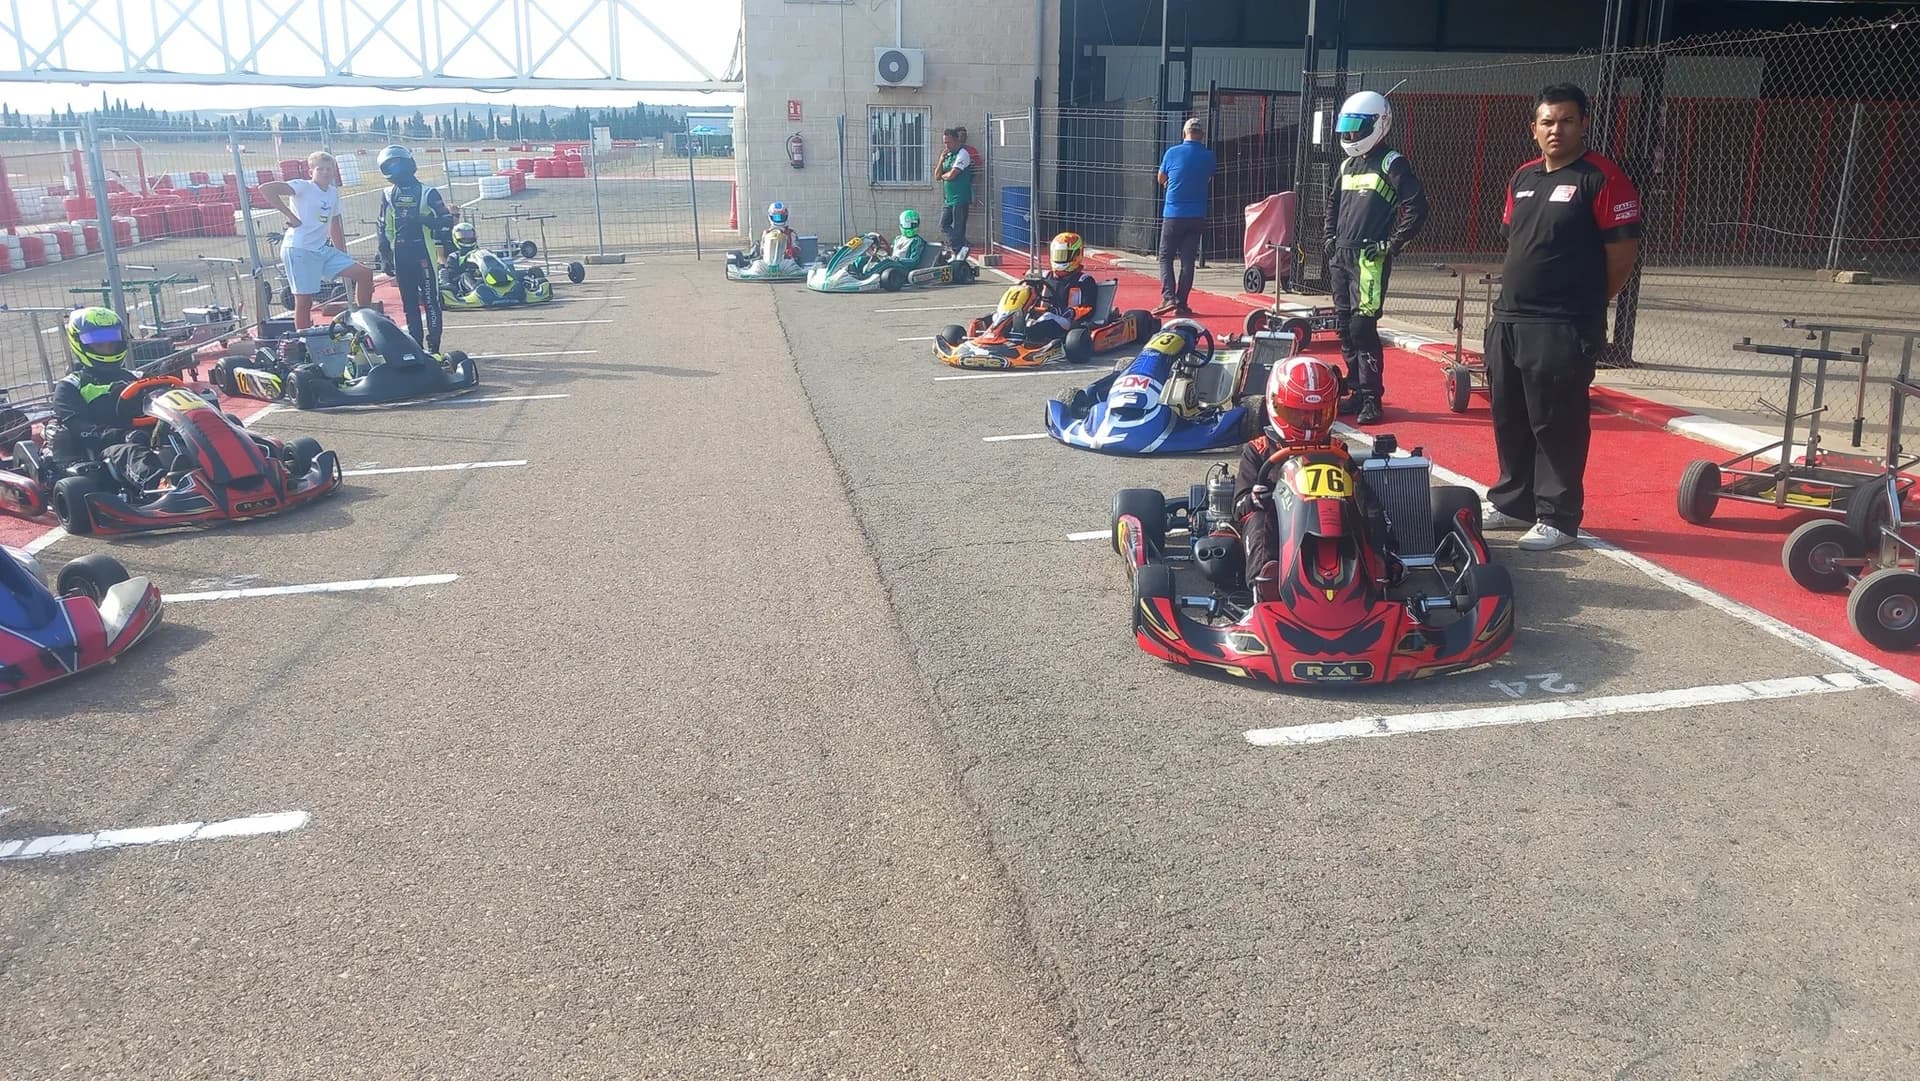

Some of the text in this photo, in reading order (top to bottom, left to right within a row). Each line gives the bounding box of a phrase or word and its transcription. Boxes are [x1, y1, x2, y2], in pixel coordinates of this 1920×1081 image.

[1004, 290, 1021, 305] 14
[1306, 468, 1345, 493] 76
[1306, 665, 1364, 676] RAL
